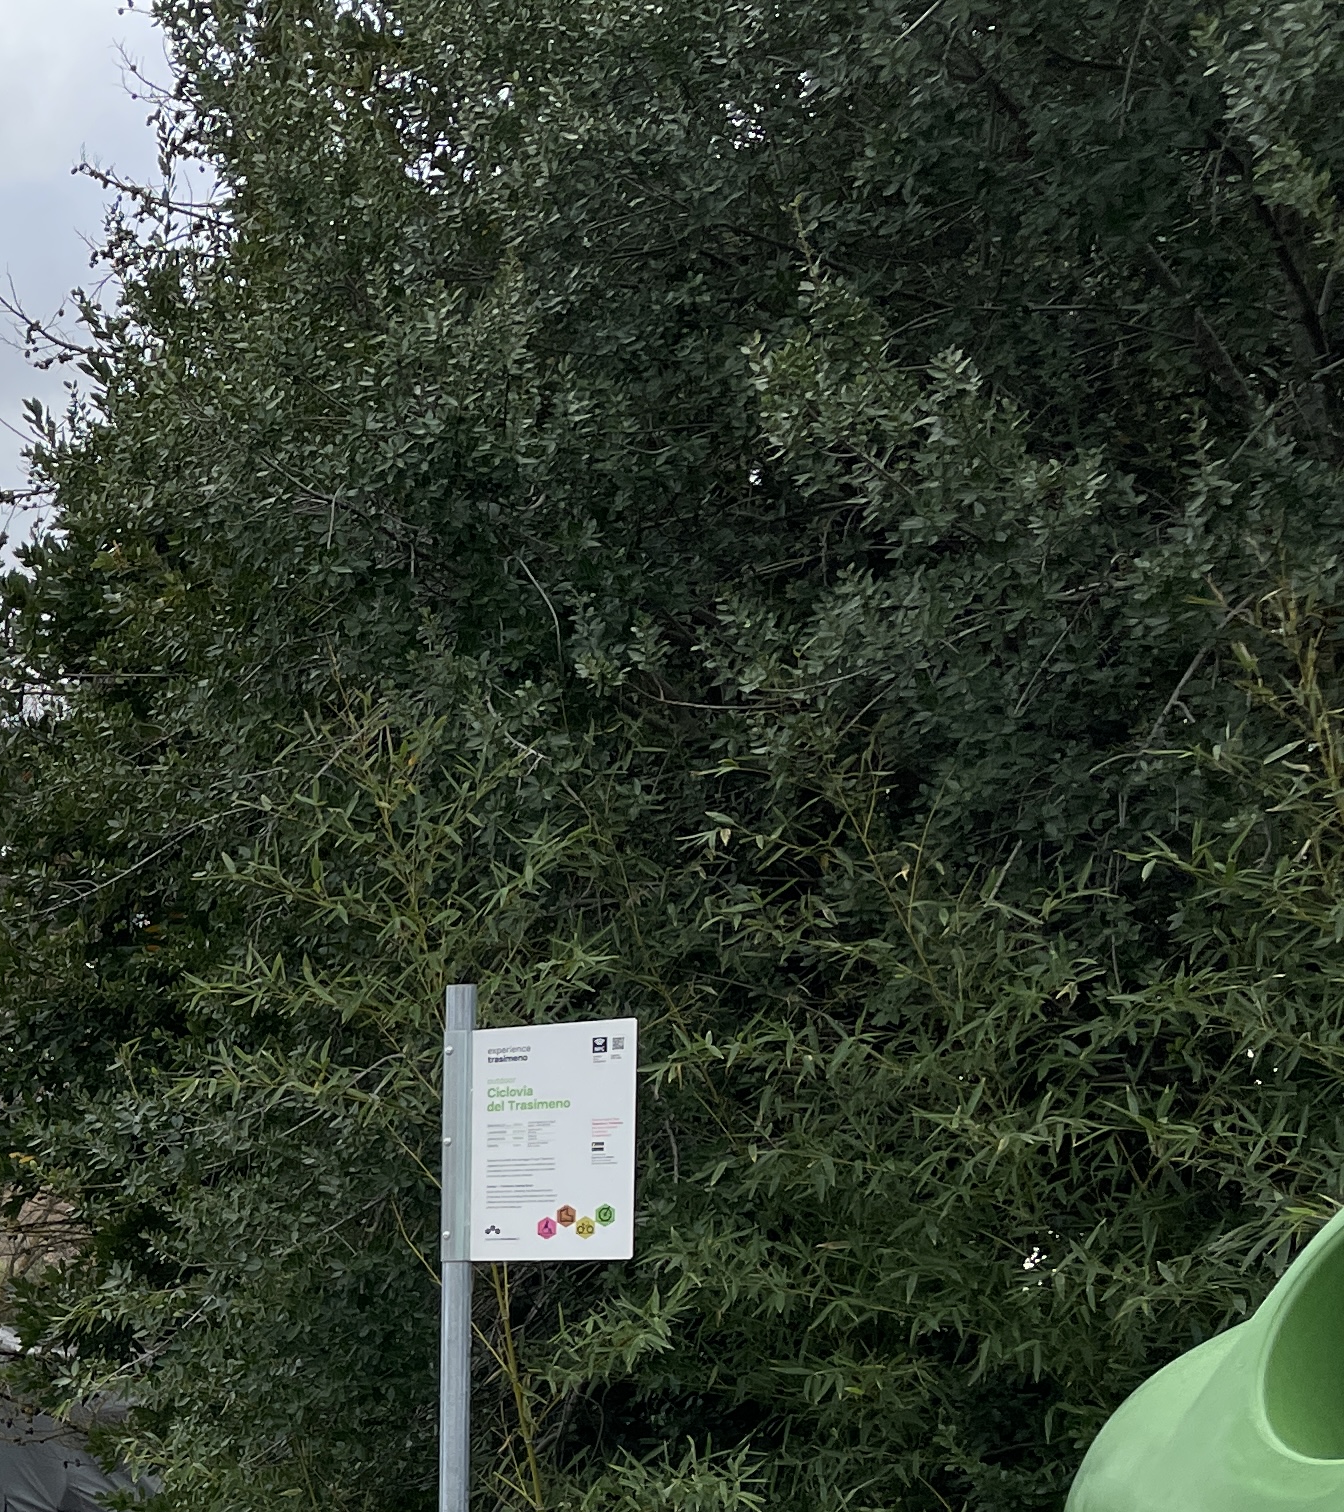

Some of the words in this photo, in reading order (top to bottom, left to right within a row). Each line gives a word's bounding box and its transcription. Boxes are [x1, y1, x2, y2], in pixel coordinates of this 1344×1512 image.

[488, 1055, 528, 1063] trasimeno
[487, 1085, 533, 1098] Ciclovia
[487, 1101, 504, 1112] del
[508, 1099, 571, 1111] Trasimeno
